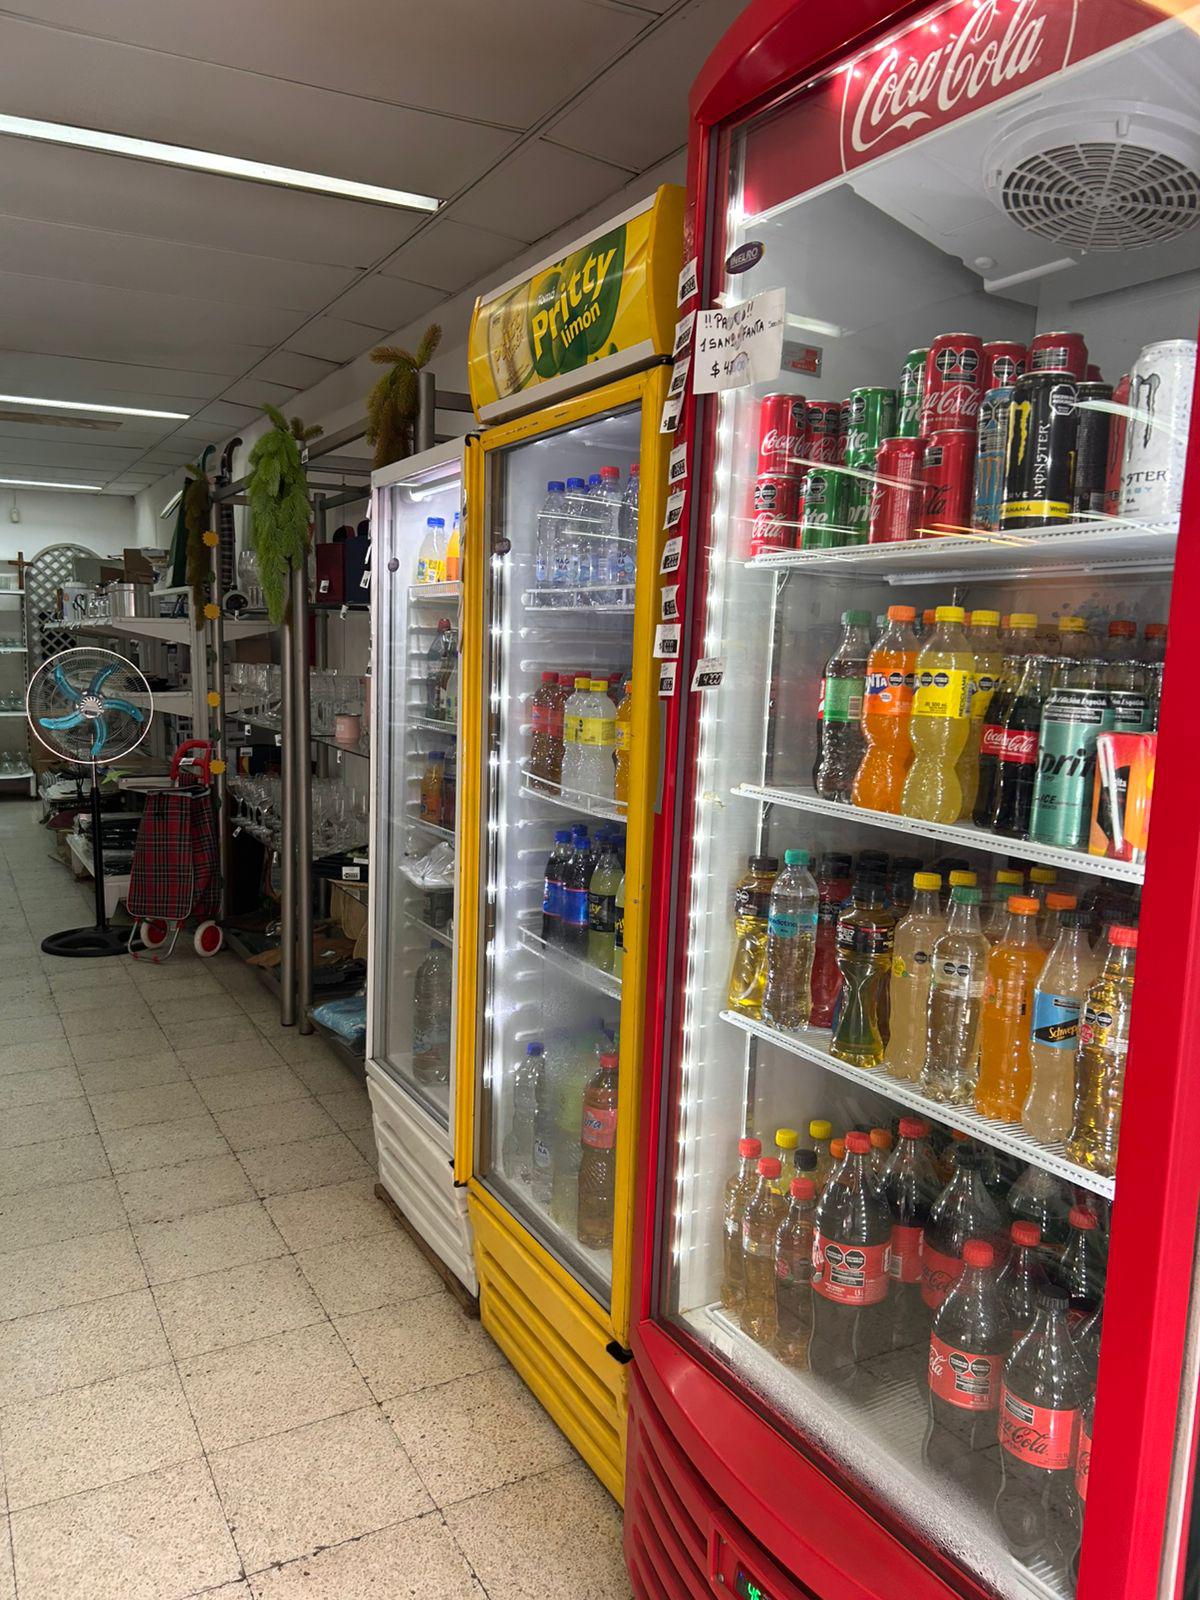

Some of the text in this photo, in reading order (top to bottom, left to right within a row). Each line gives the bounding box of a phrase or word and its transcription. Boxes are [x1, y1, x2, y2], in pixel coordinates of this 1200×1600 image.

[531, 248, 617, 362] Pritty
[560, 300, 601, 349] limón
[1033, 422, 1051, 498] MONSTER
